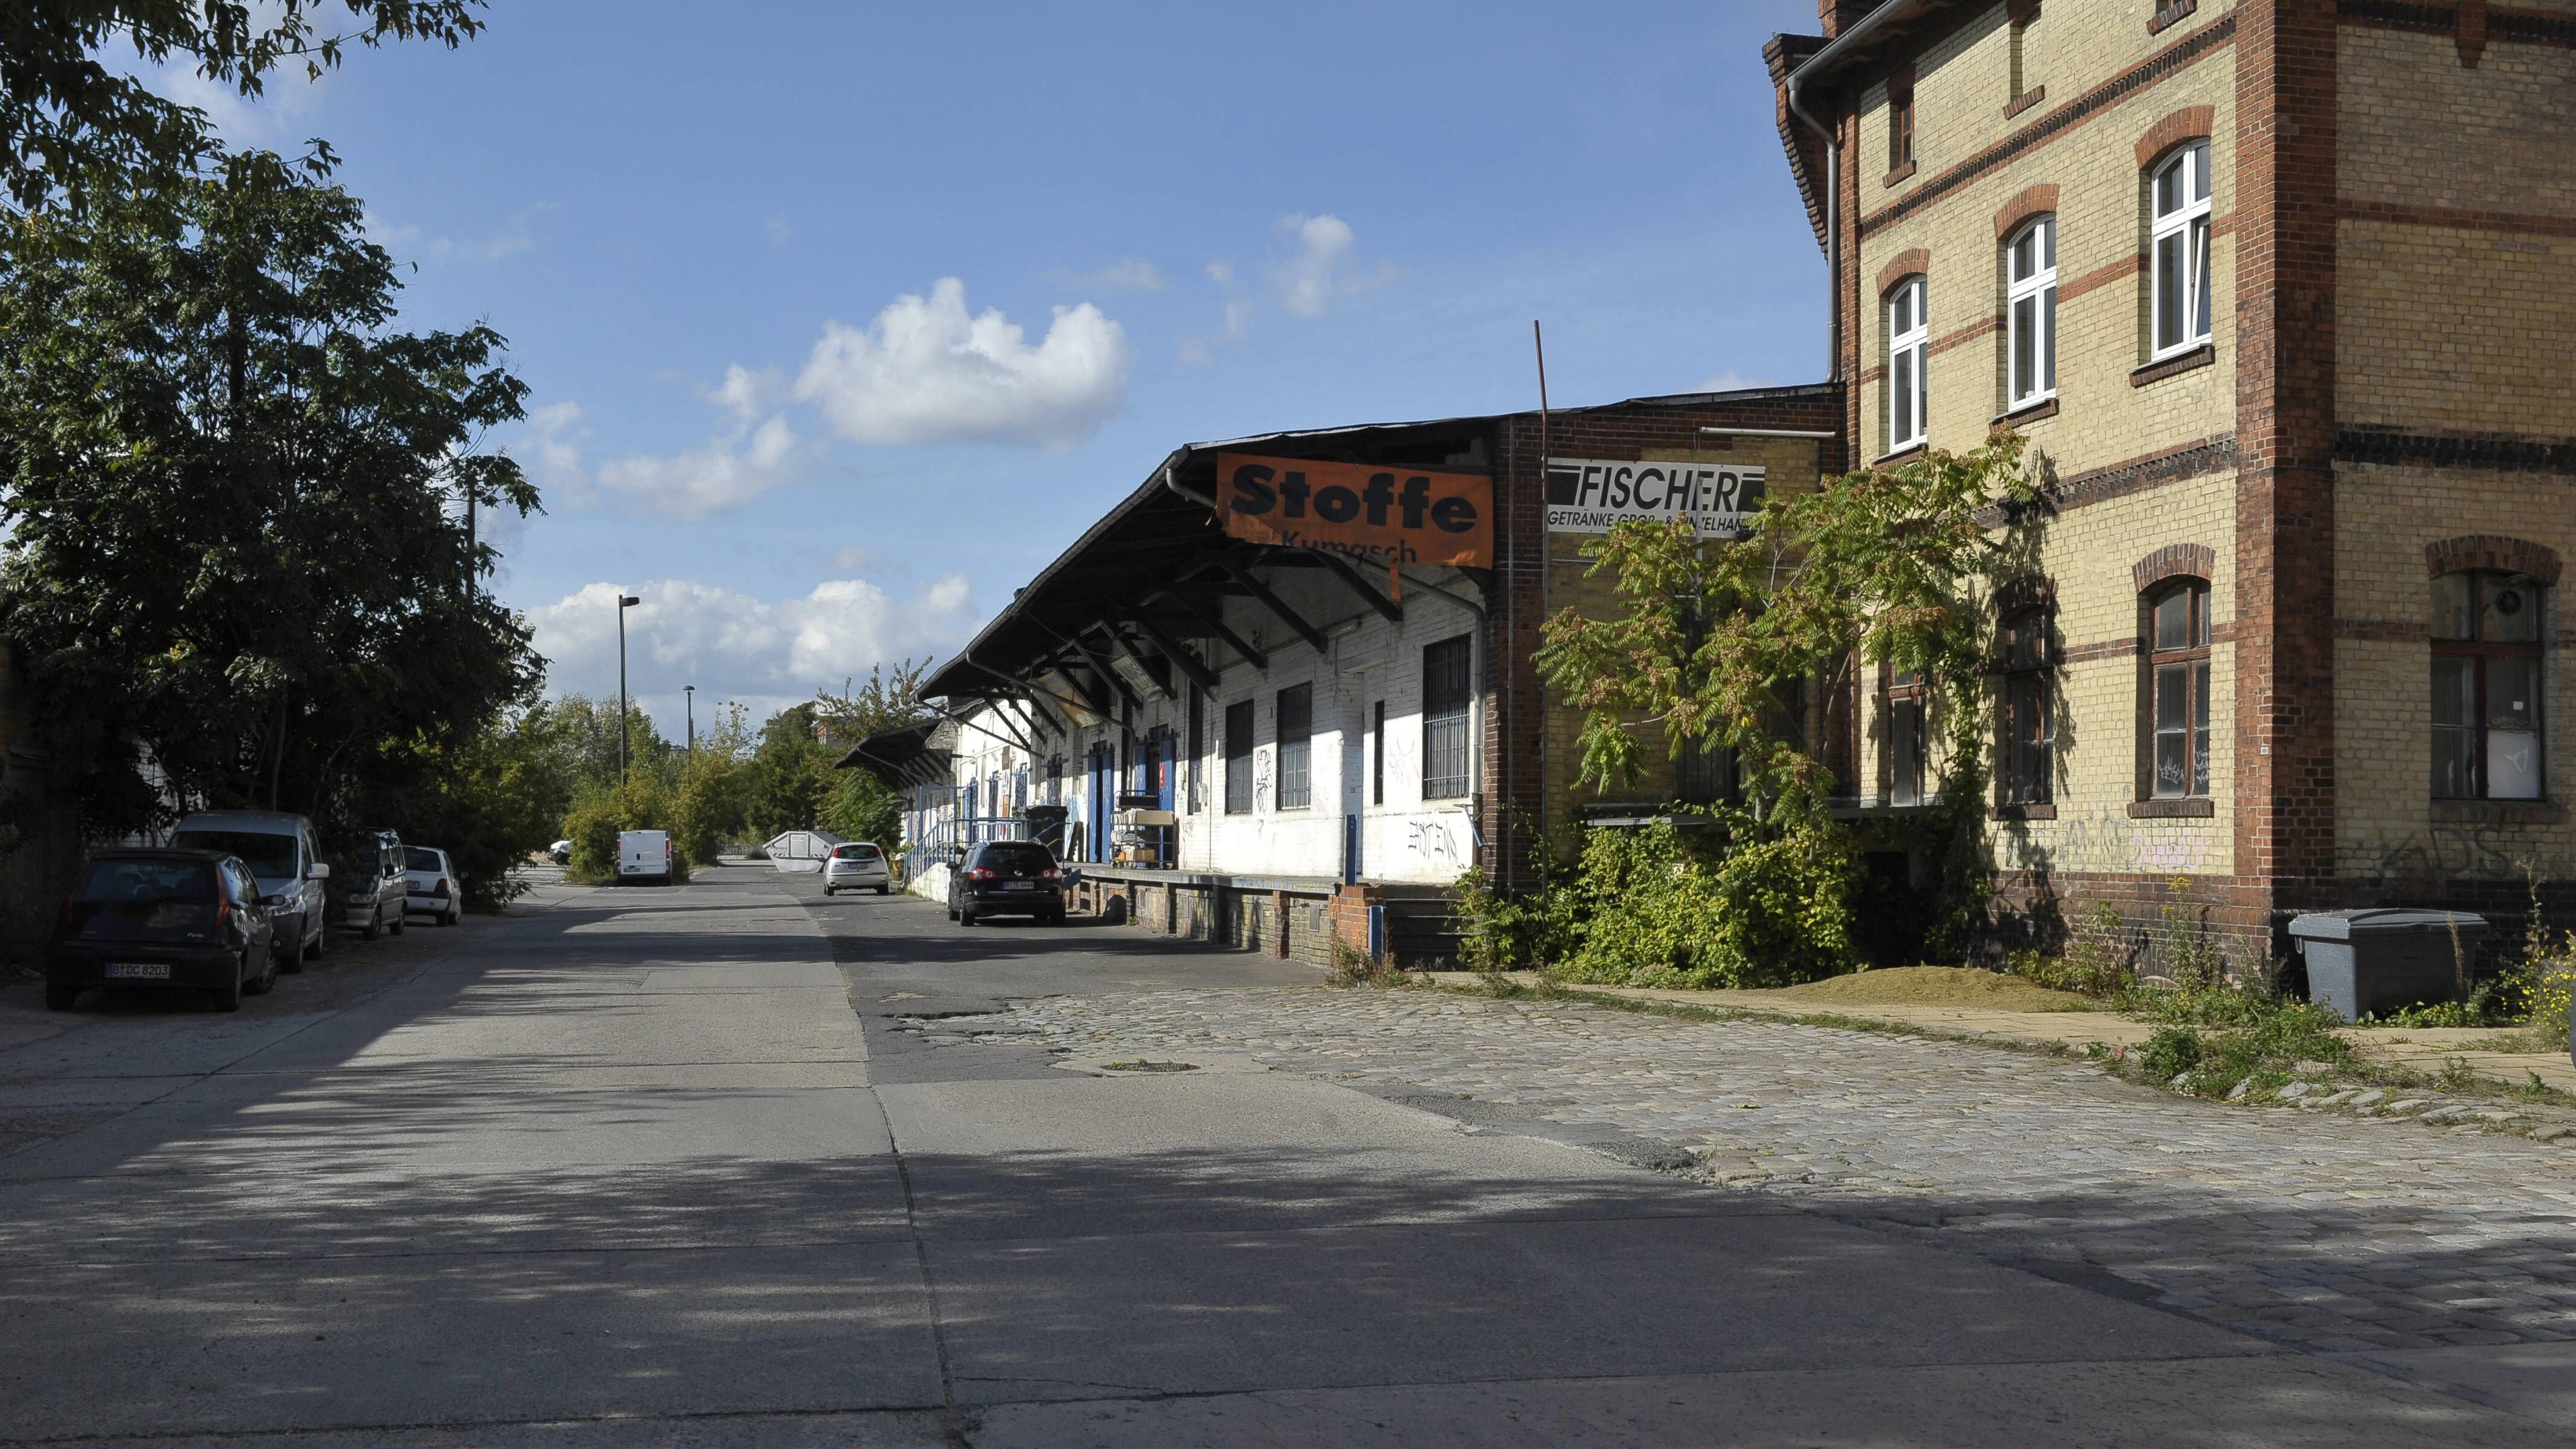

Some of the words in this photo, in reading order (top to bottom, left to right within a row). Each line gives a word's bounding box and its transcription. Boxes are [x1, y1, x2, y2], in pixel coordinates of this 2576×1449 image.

[1230, 464, 1477, 533] Stoffe
[1577, 465, 1738, 512] FISCHER
[1548, 508, 1614, 527] GETRÄNKE
[113, 965, 119, 974] B
[126, 965, 139, 975] DC
[142, 965, 168, 976] 8203
